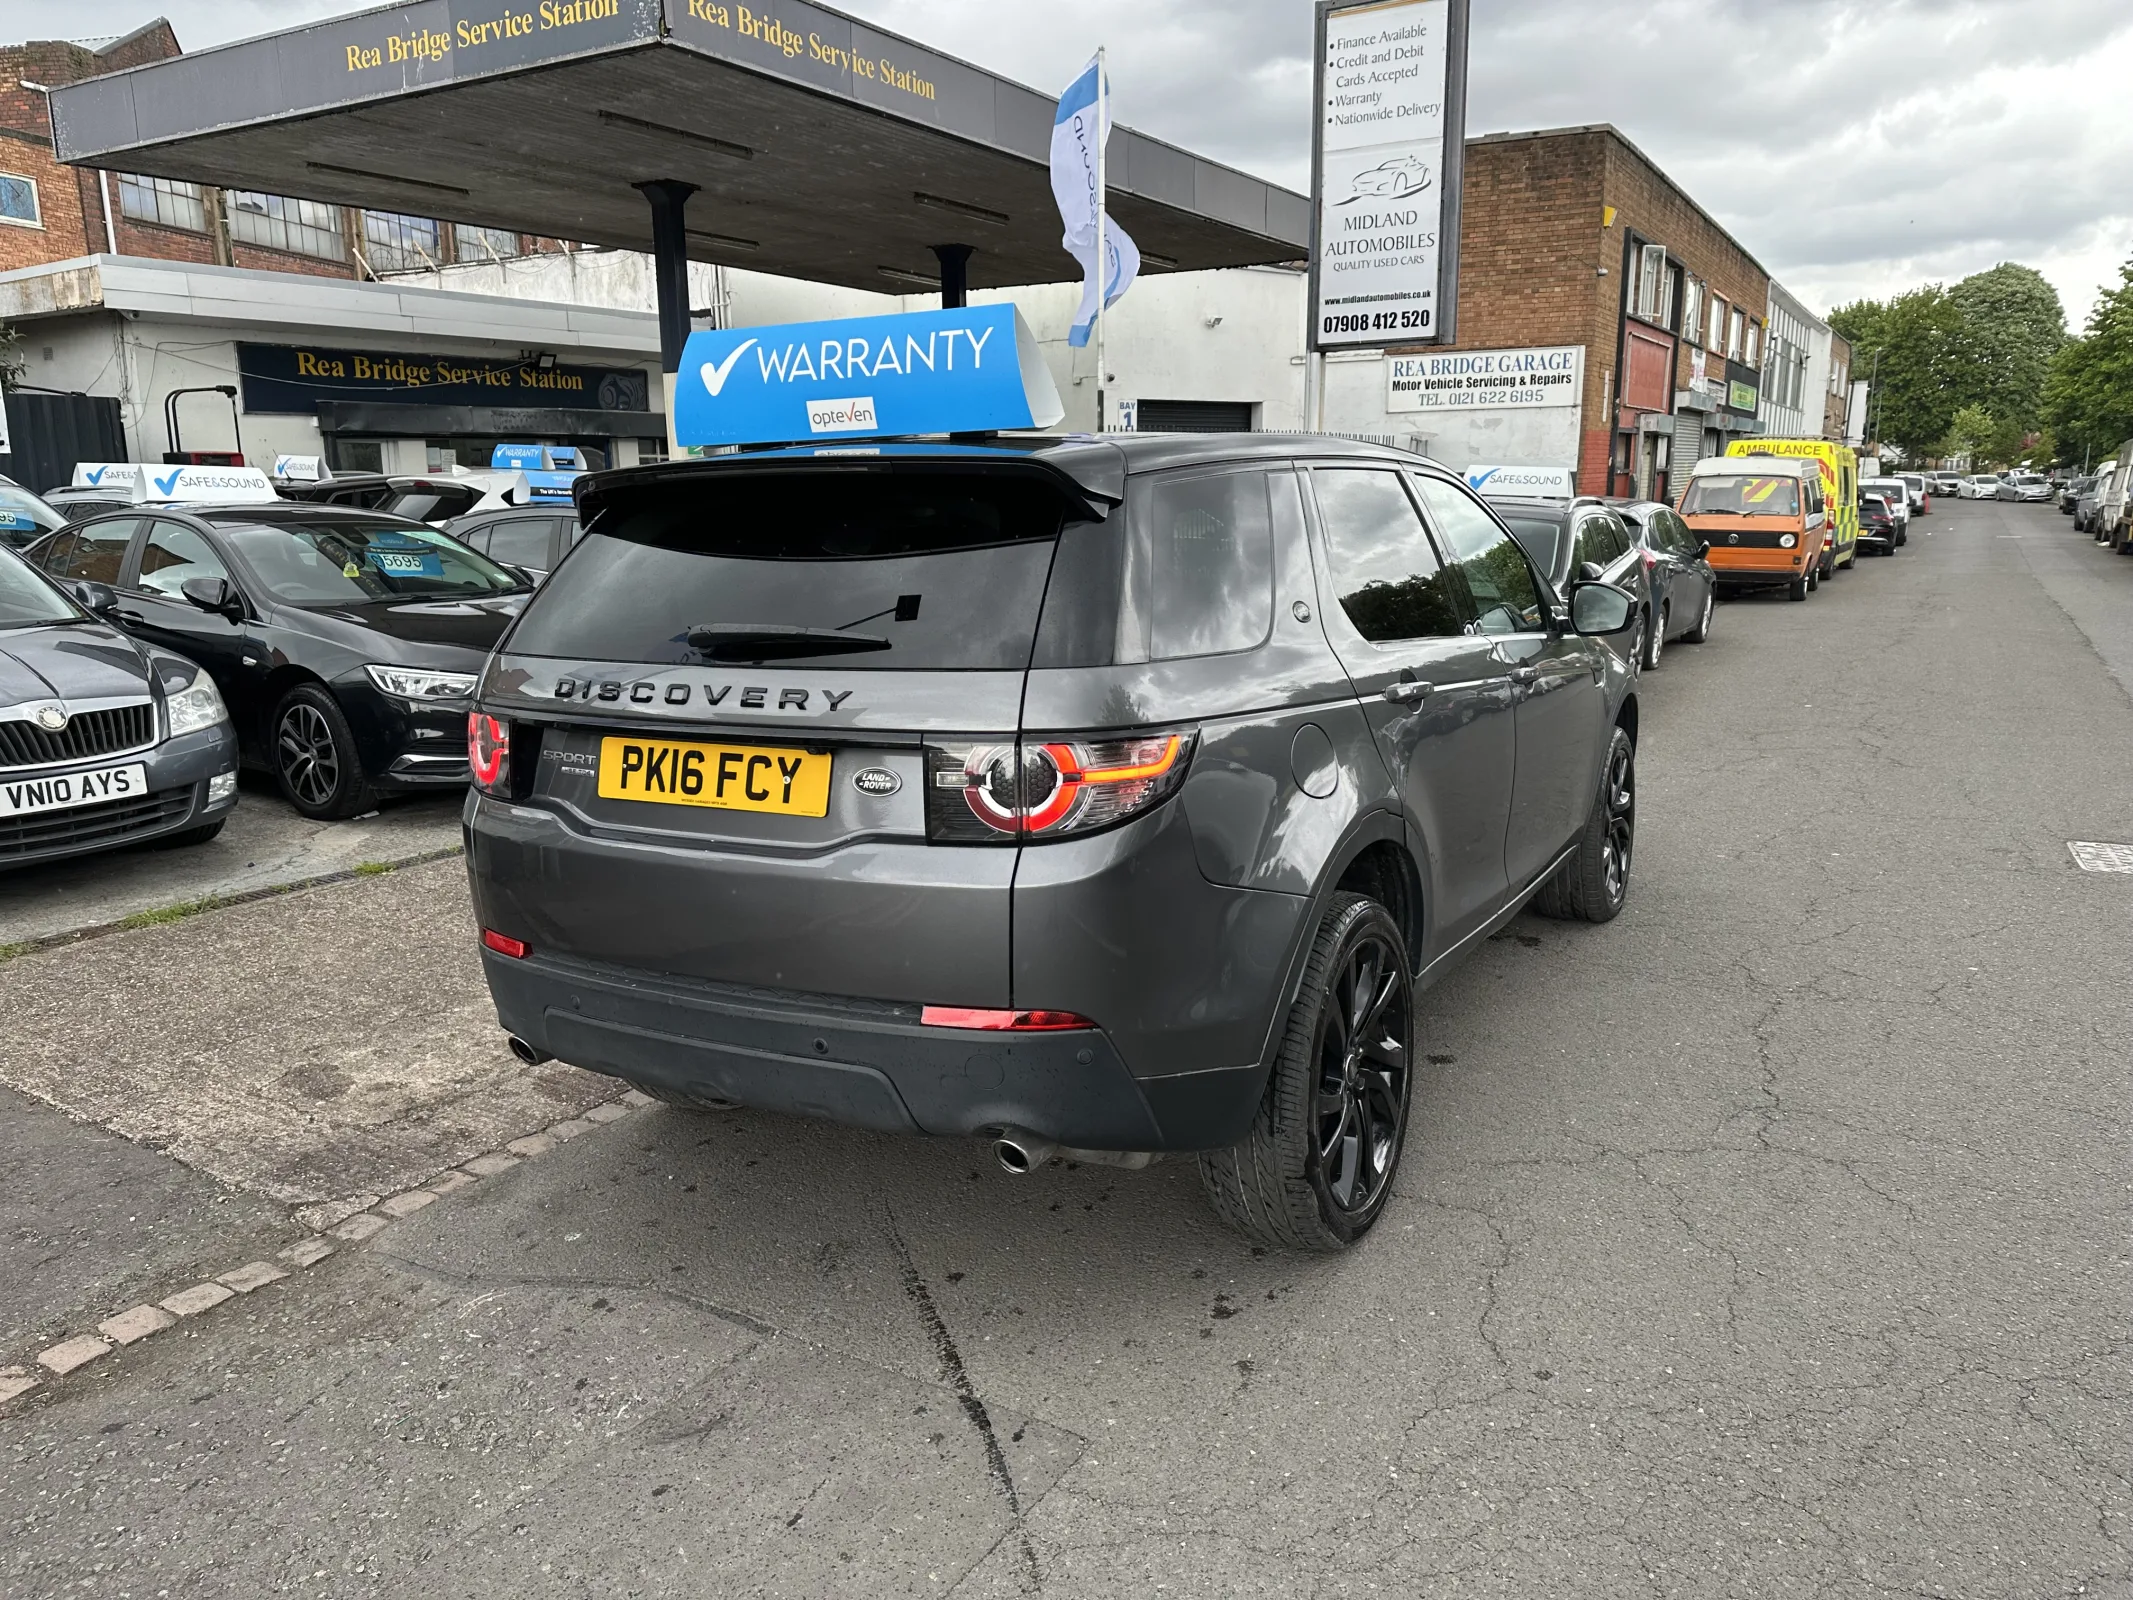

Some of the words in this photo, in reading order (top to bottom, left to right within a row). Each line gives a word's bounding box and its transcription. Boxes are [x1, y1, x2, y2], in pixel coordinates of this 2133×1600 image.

[345, 43, 382, 71] Rea
[386, 29, 451, 61] Bridge
[457, 9, 533, 48] Service
[539, 0, 619, 30] Station
[1337, 34, 1376, 50] Finance
[1379, 24, 1427, 43] Available
[687, 0, 730, 28] Rea
[736, 5, 803, 58] Bridge
[809, 33, 875, 78] Service
[880, 59, 935, 100] Station
[1336, 54, 1368, 69] Credit
[1371, 51, 1391, 64] and
[1395, 45, 1424, 60] Debit
[1336, 73, 1365, 88] Cards
[1368, 64, 1418, 84] Accepted
[1335, 91, 1382, 107] Warranty
[1335, 107, 1393, 126] Nationwide
[1397, 102, 1441, 117] Delivery
[1344, 210, 1418, 231] MIDLAND
[1325, 233, 1435, 256] AUTOMOBILES
[1333, 260, 1371, 272] QUALITY
[1374, 257, 1398, 268] USED
[1401, 255, 1424, 265] CARS
[1325, 290, 1431, 305] www.midlandautomobiles.co.uk
[1324, 314, 1369, 333] 07908
[1373, 312, 1398, 330] 412
[1401, 310, 1430, 328] 520
[757, 326, 994, 384] WARRANTY
[1394, 360, 1425, 377] REA
[1430, 357, 1495, 376] BRIDGE
[1498, 353, 1573, 373] GARAGE
[297, 352, 345, 378] Rea
[353, 356, 431, 388] Bridge
[437, 362, 511, 387] Service
[520, 368, 584, 390] Station
[1392, 380, 1421, 391] Motor
[1424, 376, 1463, 390] Vehicle
[1466, 375, 1516, 388] Servicing
[1519, 376, 1526, 386] &
[1530, 373, 1572, 387] Repairs
[1119, 402, 1136, 410] BAY
[1418, 393, 1445, 406] TEL.
[1449, 392, 1474, 405] 0121
[1479, 391, 1506, 404] 622
[1510, 389, 1544, 403] 6195
[1123, 411, 1132, 427] 1
[505, 448, 540, 457] WARRANTY
[1737, 444, 1822, 456] AMBULANCE
[179, 476, 265, 490] SAFE&SOUND
[1489, 474, 1562, 485] SAFE&SOUND
[554, 678, 855, 713] DISCOVERY
[543, 750, 597, 765] SPORT
[619, 744, 705, 796] PK16
[718, 751, 802, 804] FCY
[862, 773, 885, 782] LAND
[5, 779, 73, 809] VN10
[80, 769, 131, 799] AYS
[863, 781, 892, 790] ROVER
